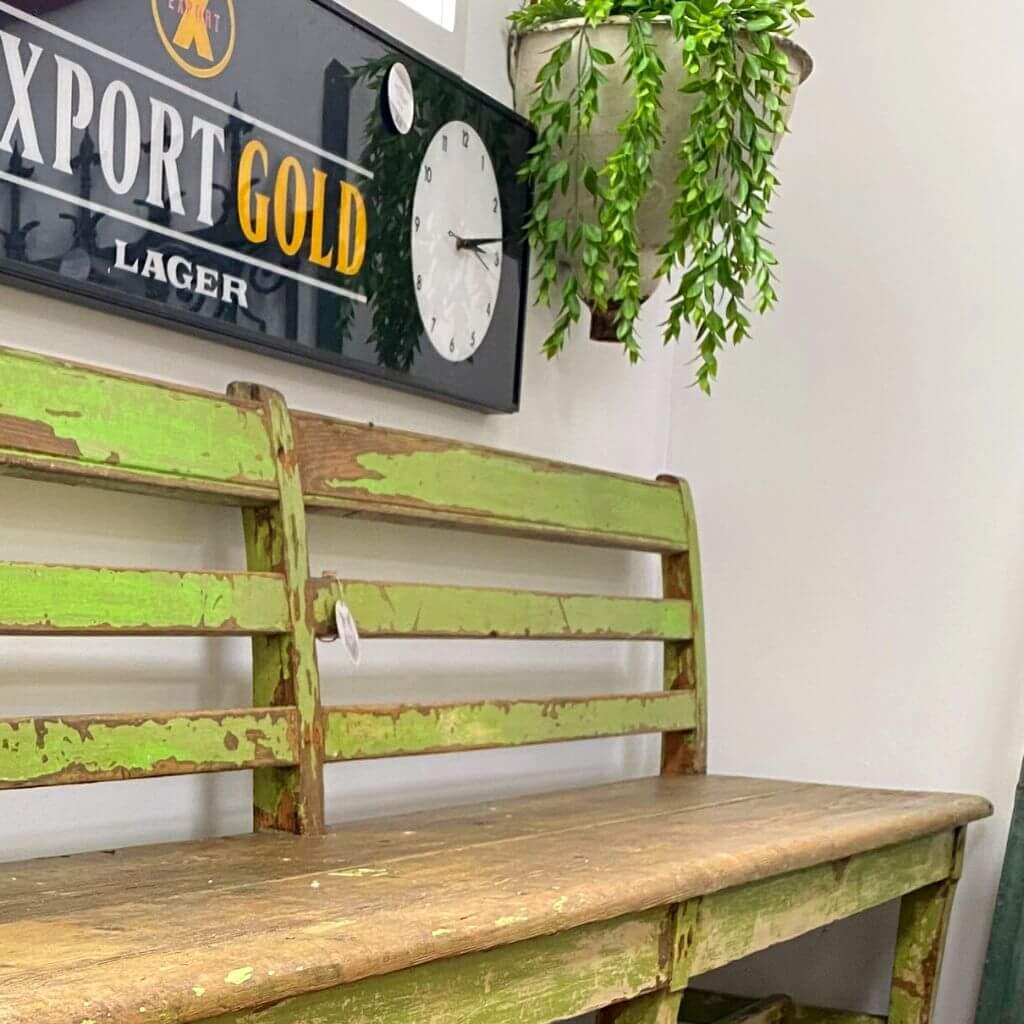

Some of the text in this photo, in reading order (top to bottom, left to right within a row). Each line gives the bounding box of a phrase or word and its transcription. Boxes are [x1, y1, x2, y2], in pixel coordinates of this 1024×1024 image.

[442, 135, 448, 153] 11
[462, 130, 470, 149] 12
[424, 164, 432, 183] 10
[237, 139, 367, 276] GOLD
[492, 197, 498, 213] 2
[414, 216, 420, 232] 9
[114, 239, 248, 308] LAGER
[416, 274, 422, 291] 8
[431, 317, 436, 334] 7
[449, 337, 455, 353] 6
